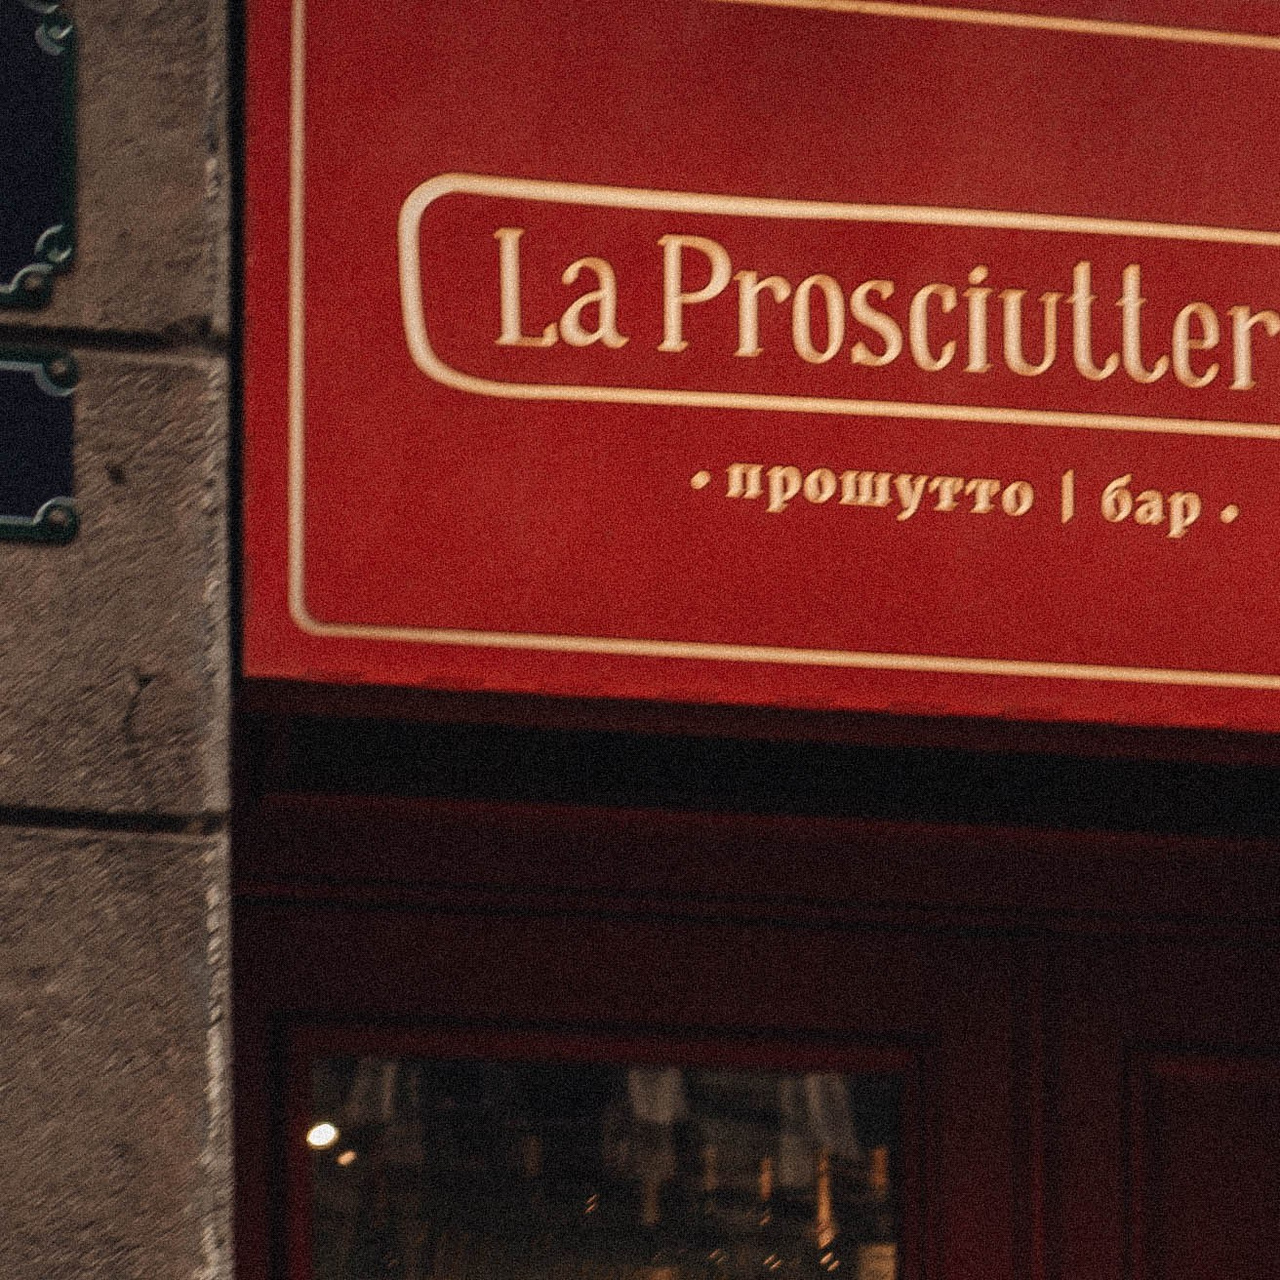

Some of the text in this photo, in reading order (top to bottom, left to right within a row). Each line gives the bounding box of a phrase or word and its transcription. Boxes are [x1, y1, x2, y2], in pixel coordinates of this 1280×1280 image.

[494, 228, 629, 349] La
[725, 462, 1202, 539] прошутто бар
